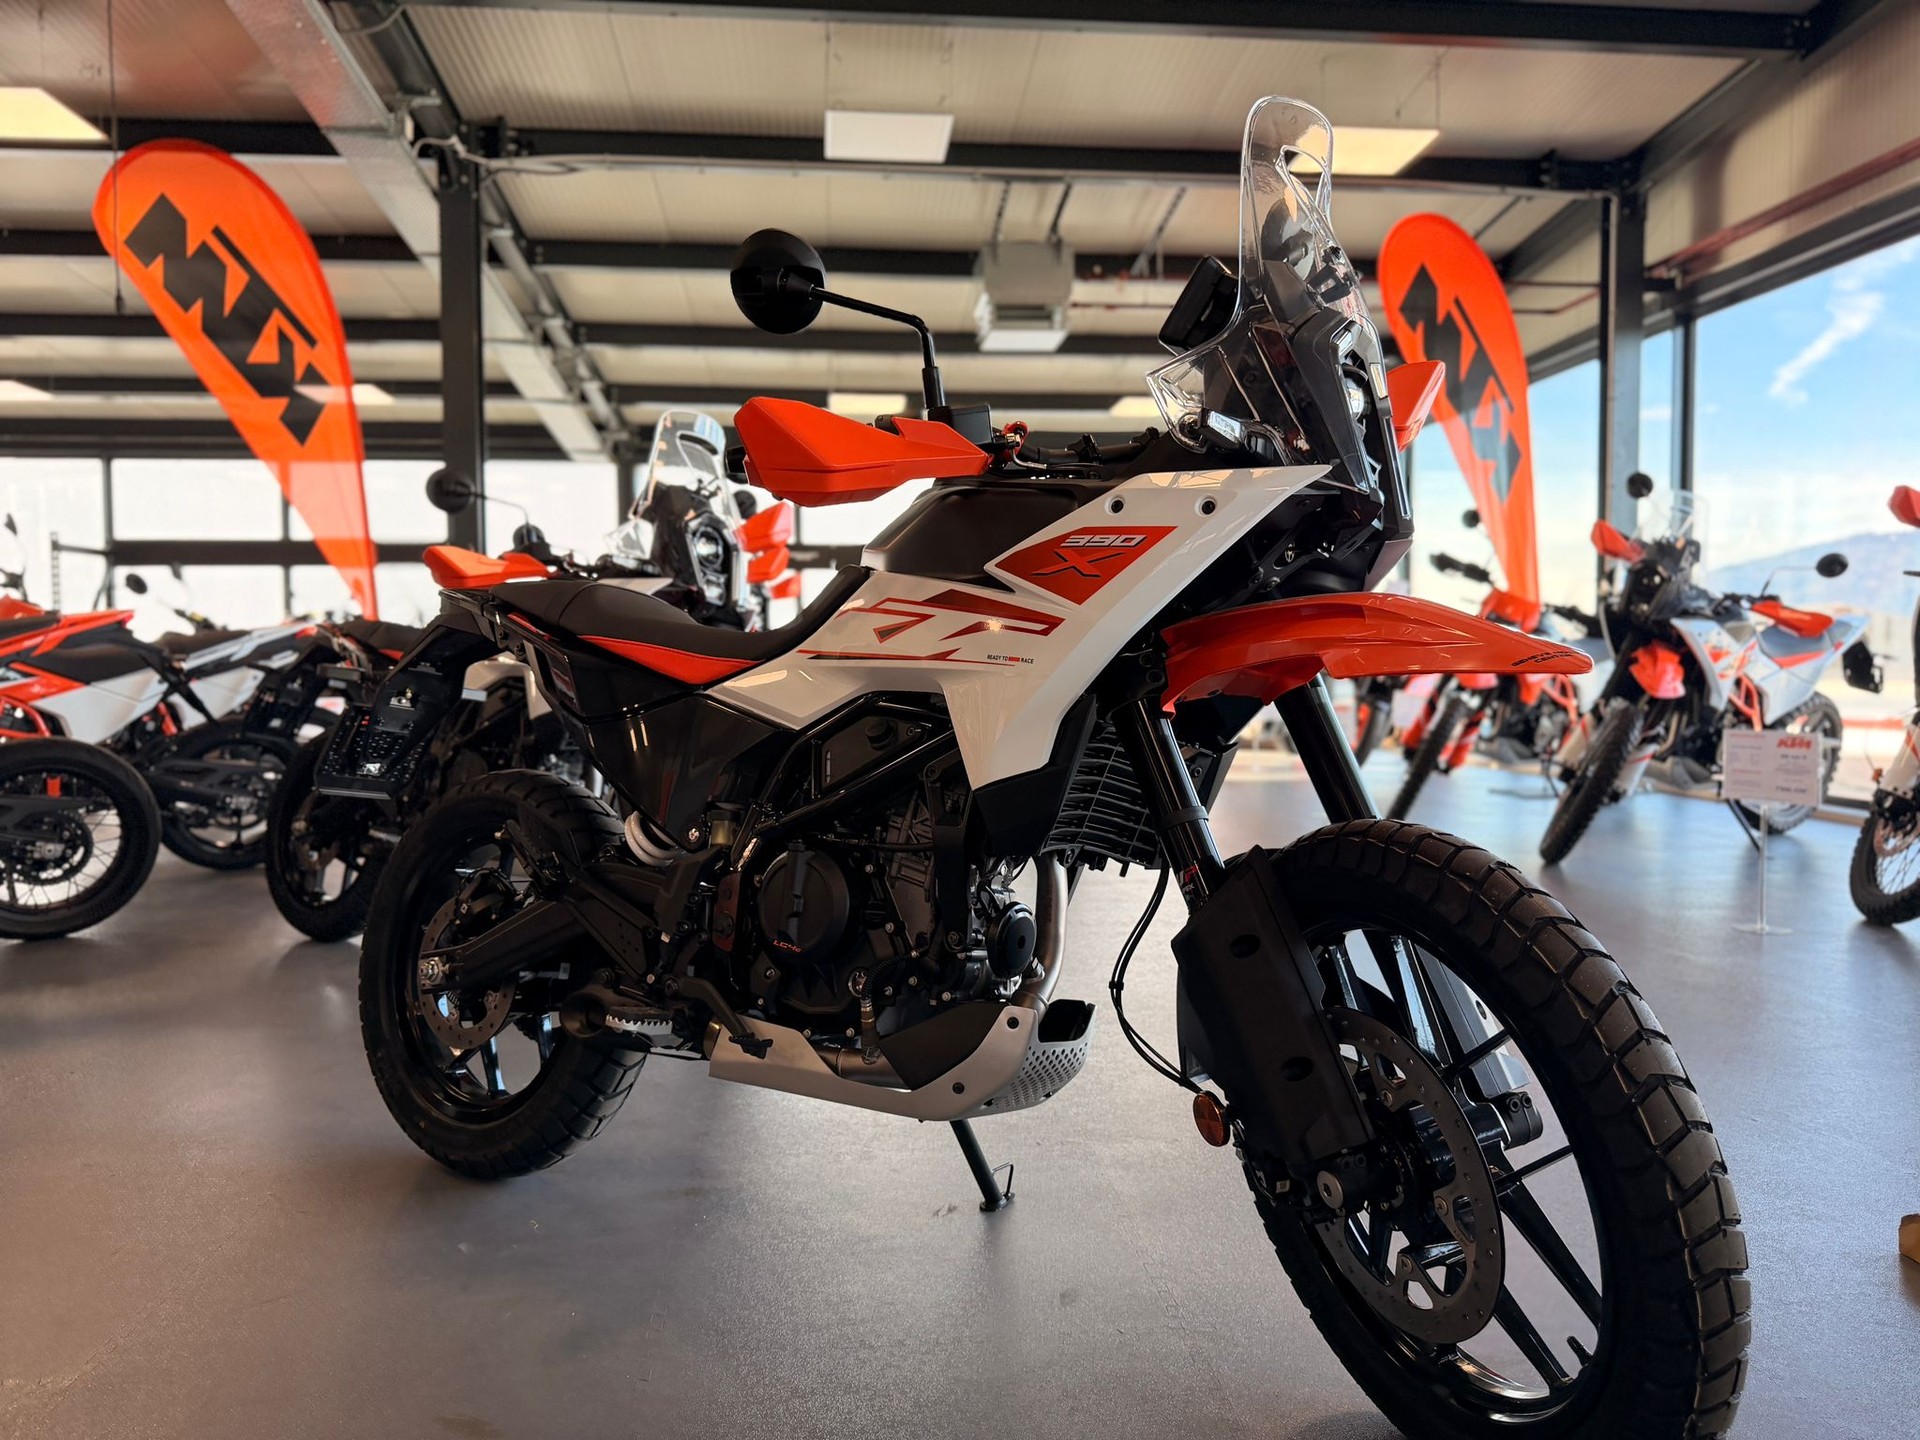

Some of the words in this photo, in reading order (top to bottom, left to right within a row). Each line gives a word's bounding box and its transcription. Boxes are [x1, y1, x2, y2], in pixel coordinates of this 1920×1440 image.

[1060, 534, 1147, 548] 390
[1031, 548, 1126, 577] X
[1020, 657, 1034, 665] RACE
